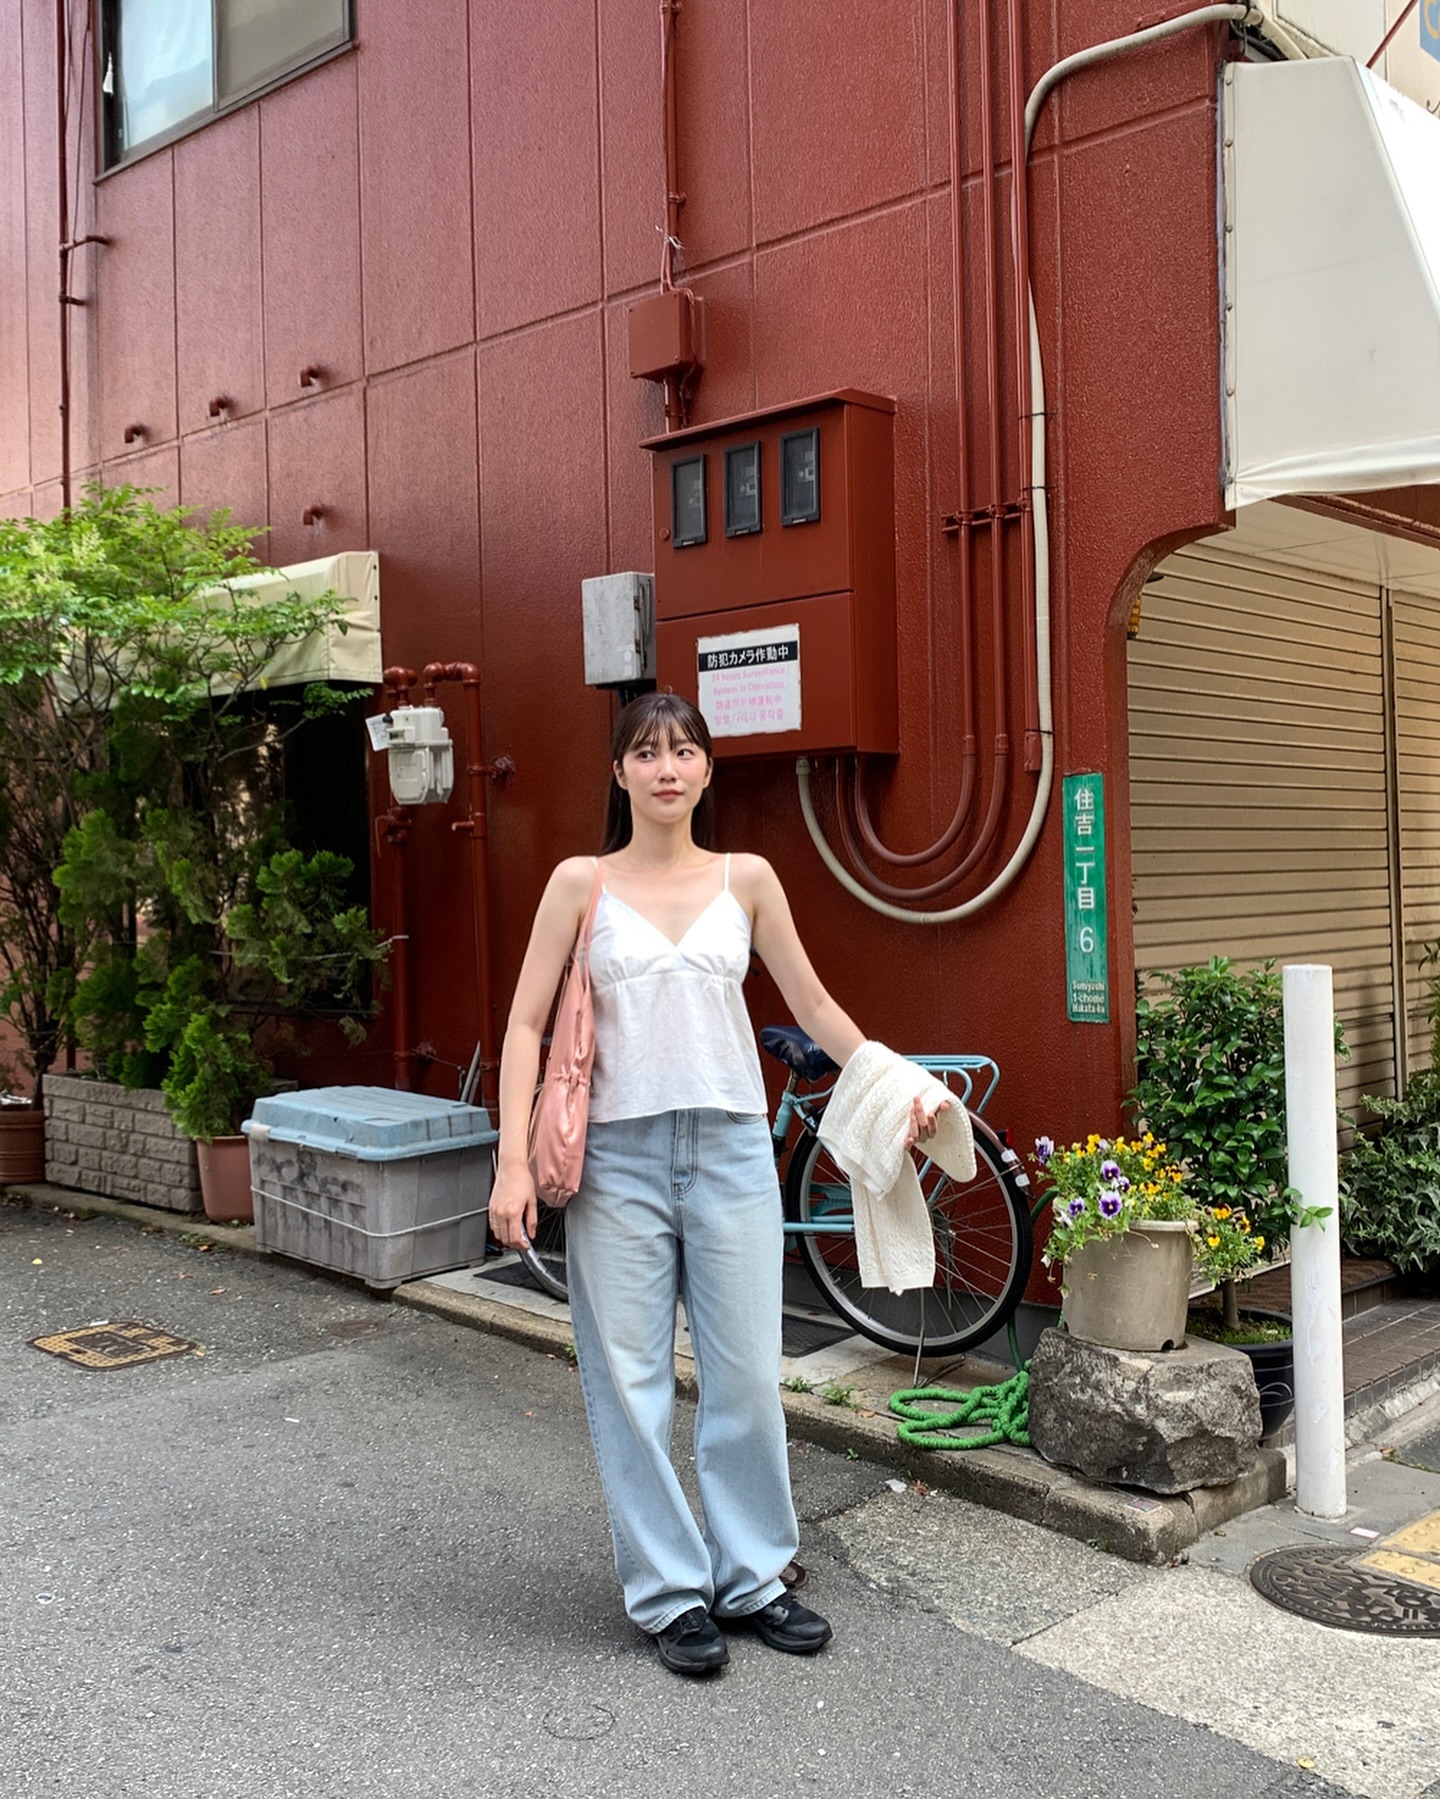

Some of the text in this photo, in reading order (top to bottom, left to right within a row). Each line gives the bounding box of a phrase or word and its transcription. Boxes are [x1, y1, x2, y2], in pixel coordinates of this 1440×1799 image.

[707, 645, 789, 669] 防犯カメラ作動中
[721, 672, 741, 681] hours
[743, 667, 785, 679] Surveillance
[713, 686, 738, 697] System
[748, 681, 784, 692] Operation
[1074, 788, 1096, 953] 住吉一丁目 6
[1072, 980, 1105, 992] Sumiyoshi
[1073, 992, 1105, 1003] 1-chome
[1072, 1003, 1105, 1014] Hakata-ku
